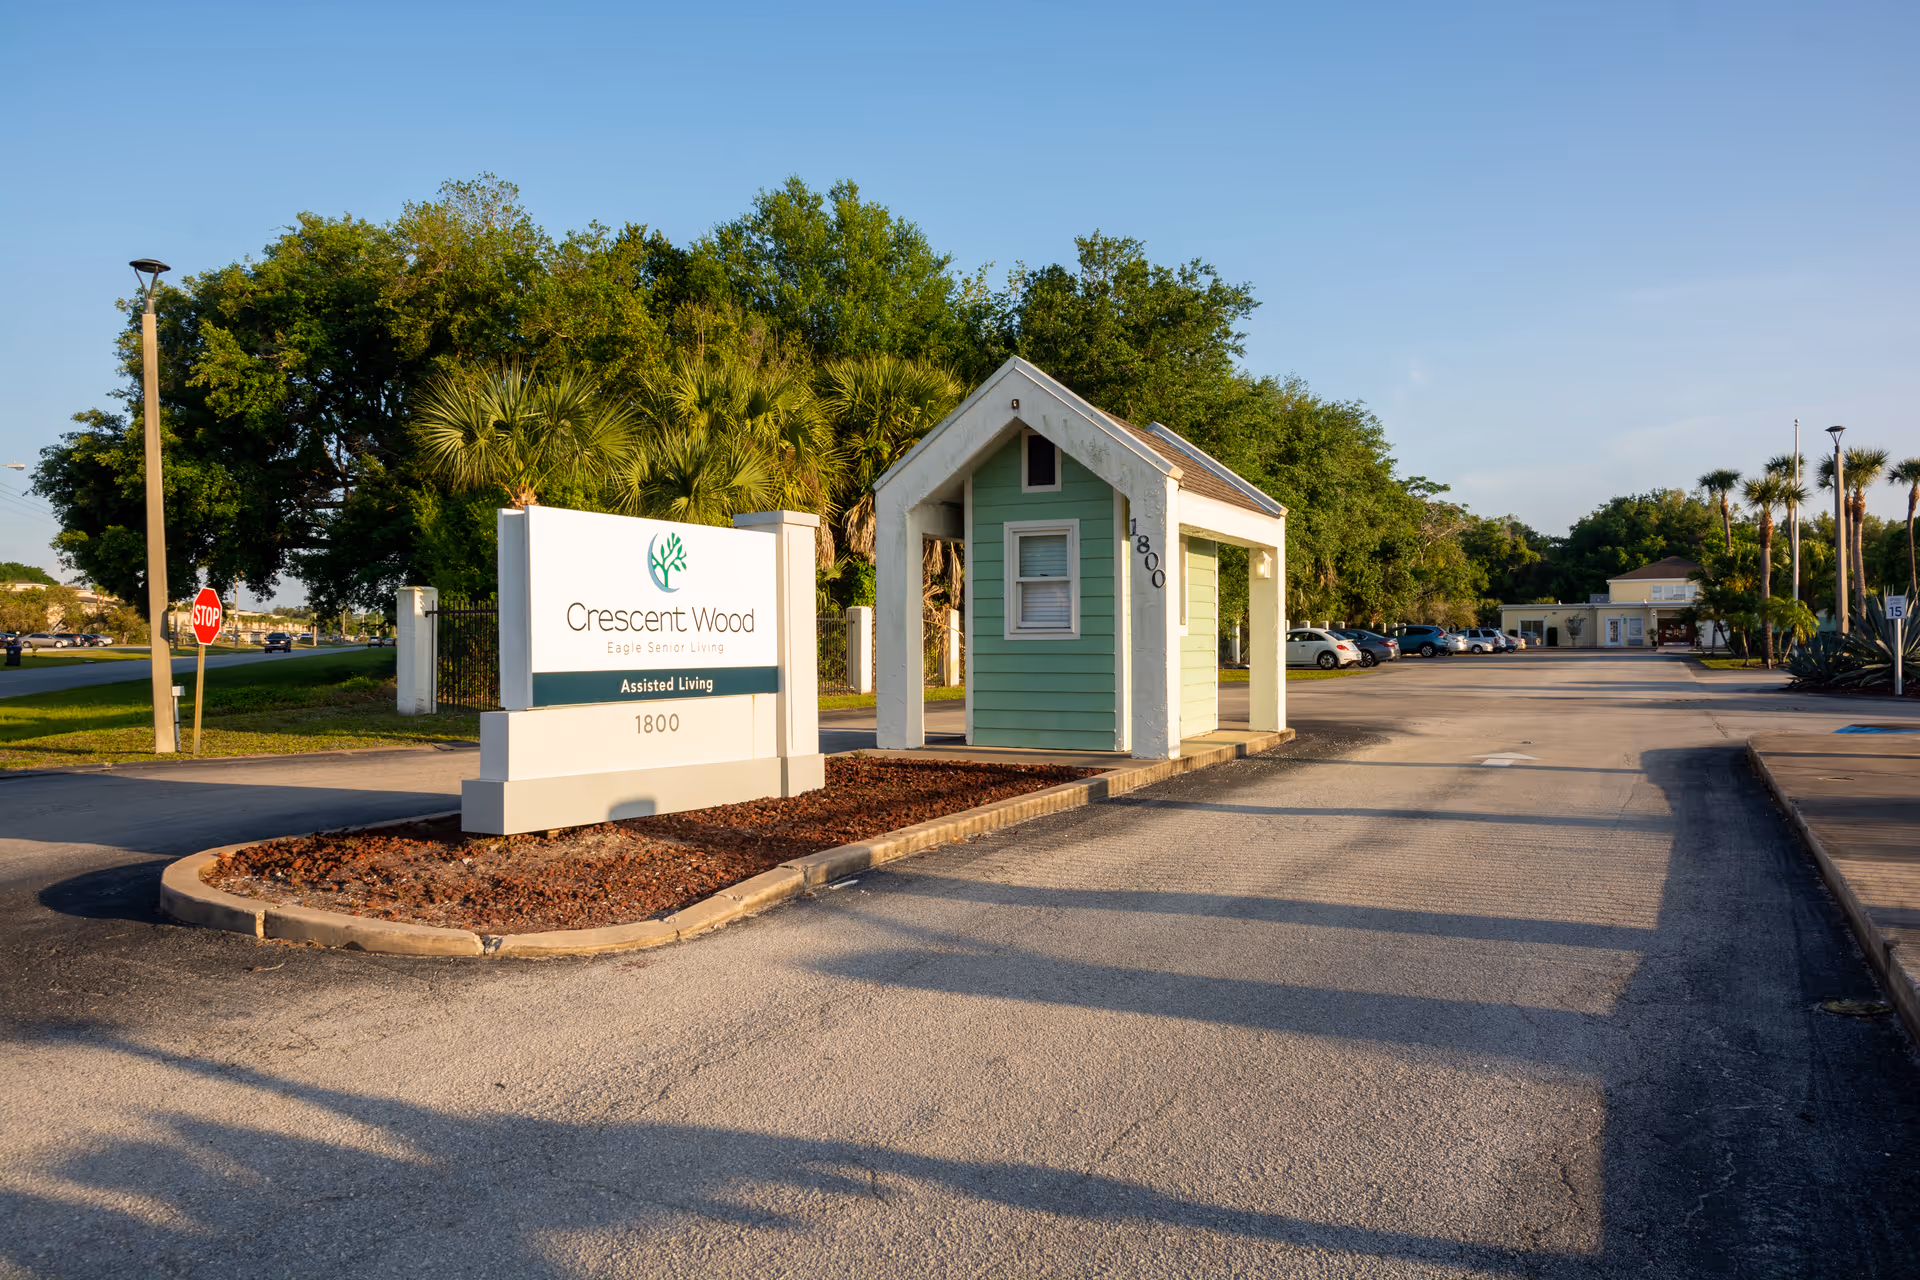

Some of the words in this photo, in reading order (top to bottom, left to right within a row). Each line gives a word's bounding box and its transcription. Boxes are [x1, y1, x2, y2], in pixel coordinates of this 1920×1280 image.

[1130, 518, 1166, 588] 1800
[194, 604, 220, 628] STOP
[566, 602, 687, 632] Crescent
[691, 606, 755, 633] Wood
[1889, 606, 1902, 617] 15
[607, 641, 642, 656] Eagle
[647, 641, 685, 653] Senior
[690, 641, 724, 655] Living
[620, 676, 674, 694] Assisted
[678, 676, 714, 693] Living
[635, 713, 680, 734] 1800
